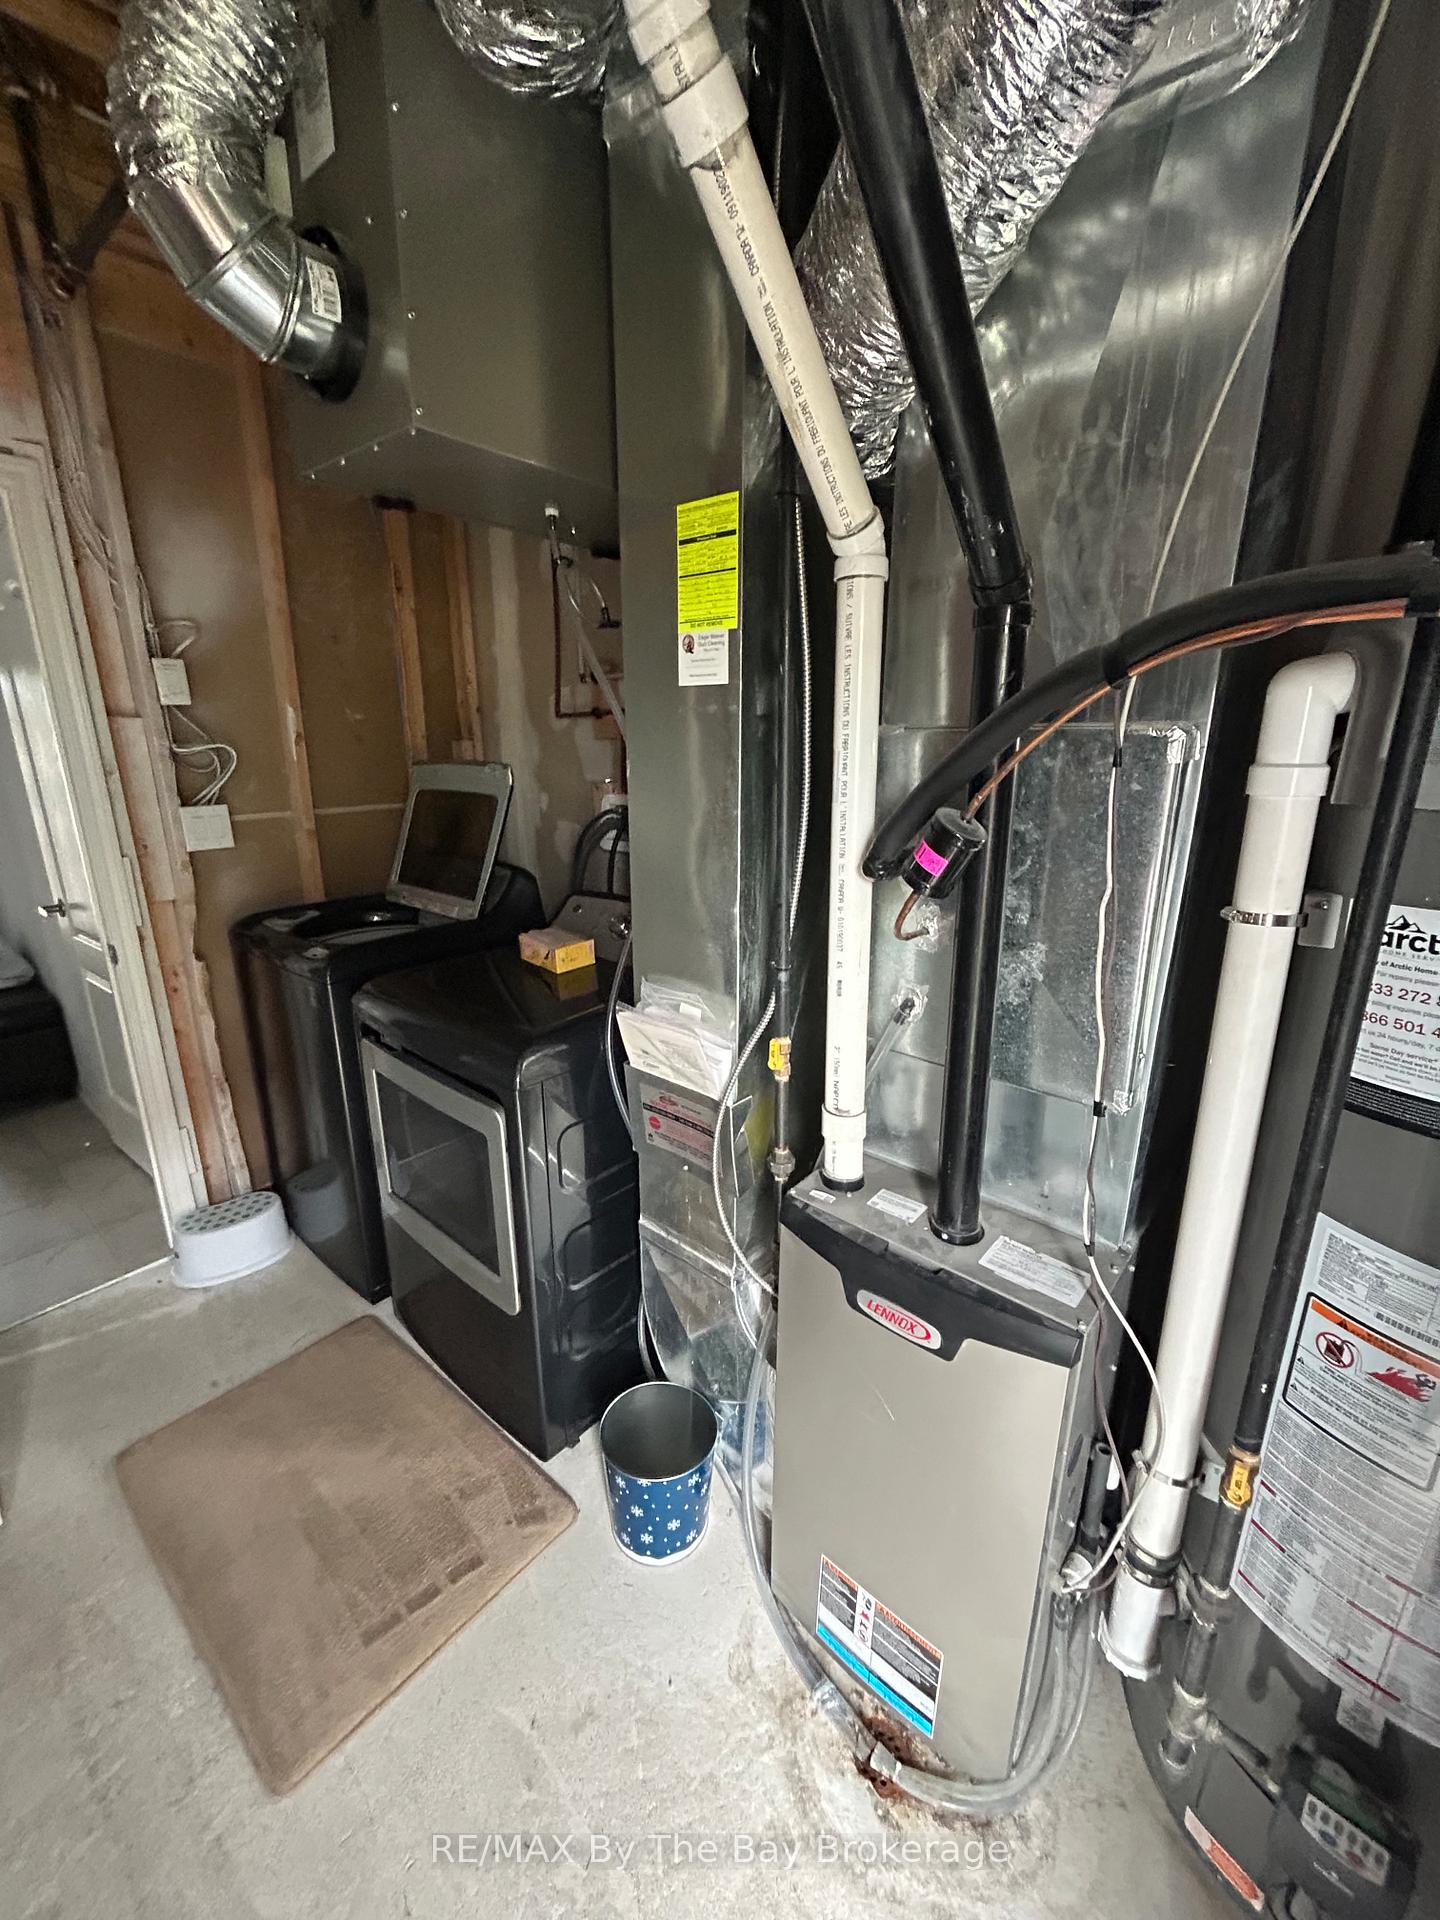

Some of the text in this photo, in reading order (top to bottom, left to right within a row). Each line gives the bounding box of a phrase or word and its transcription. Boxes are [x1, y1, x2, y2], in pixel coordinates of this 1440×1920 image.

[790, 376, 805, 397] POUR
[815, 444, 826, 456] DU
[819, 455, 844, 505] INSTRUCTIONS
[838, 505, 850, 520] LES
[1390, 962, 1413, 972] Arctic
[1397, 988, 1432, 1006] 272
[1393, 1018, 1426, 1036] 501
[866, 1299, 918, 1335] LENNOX
